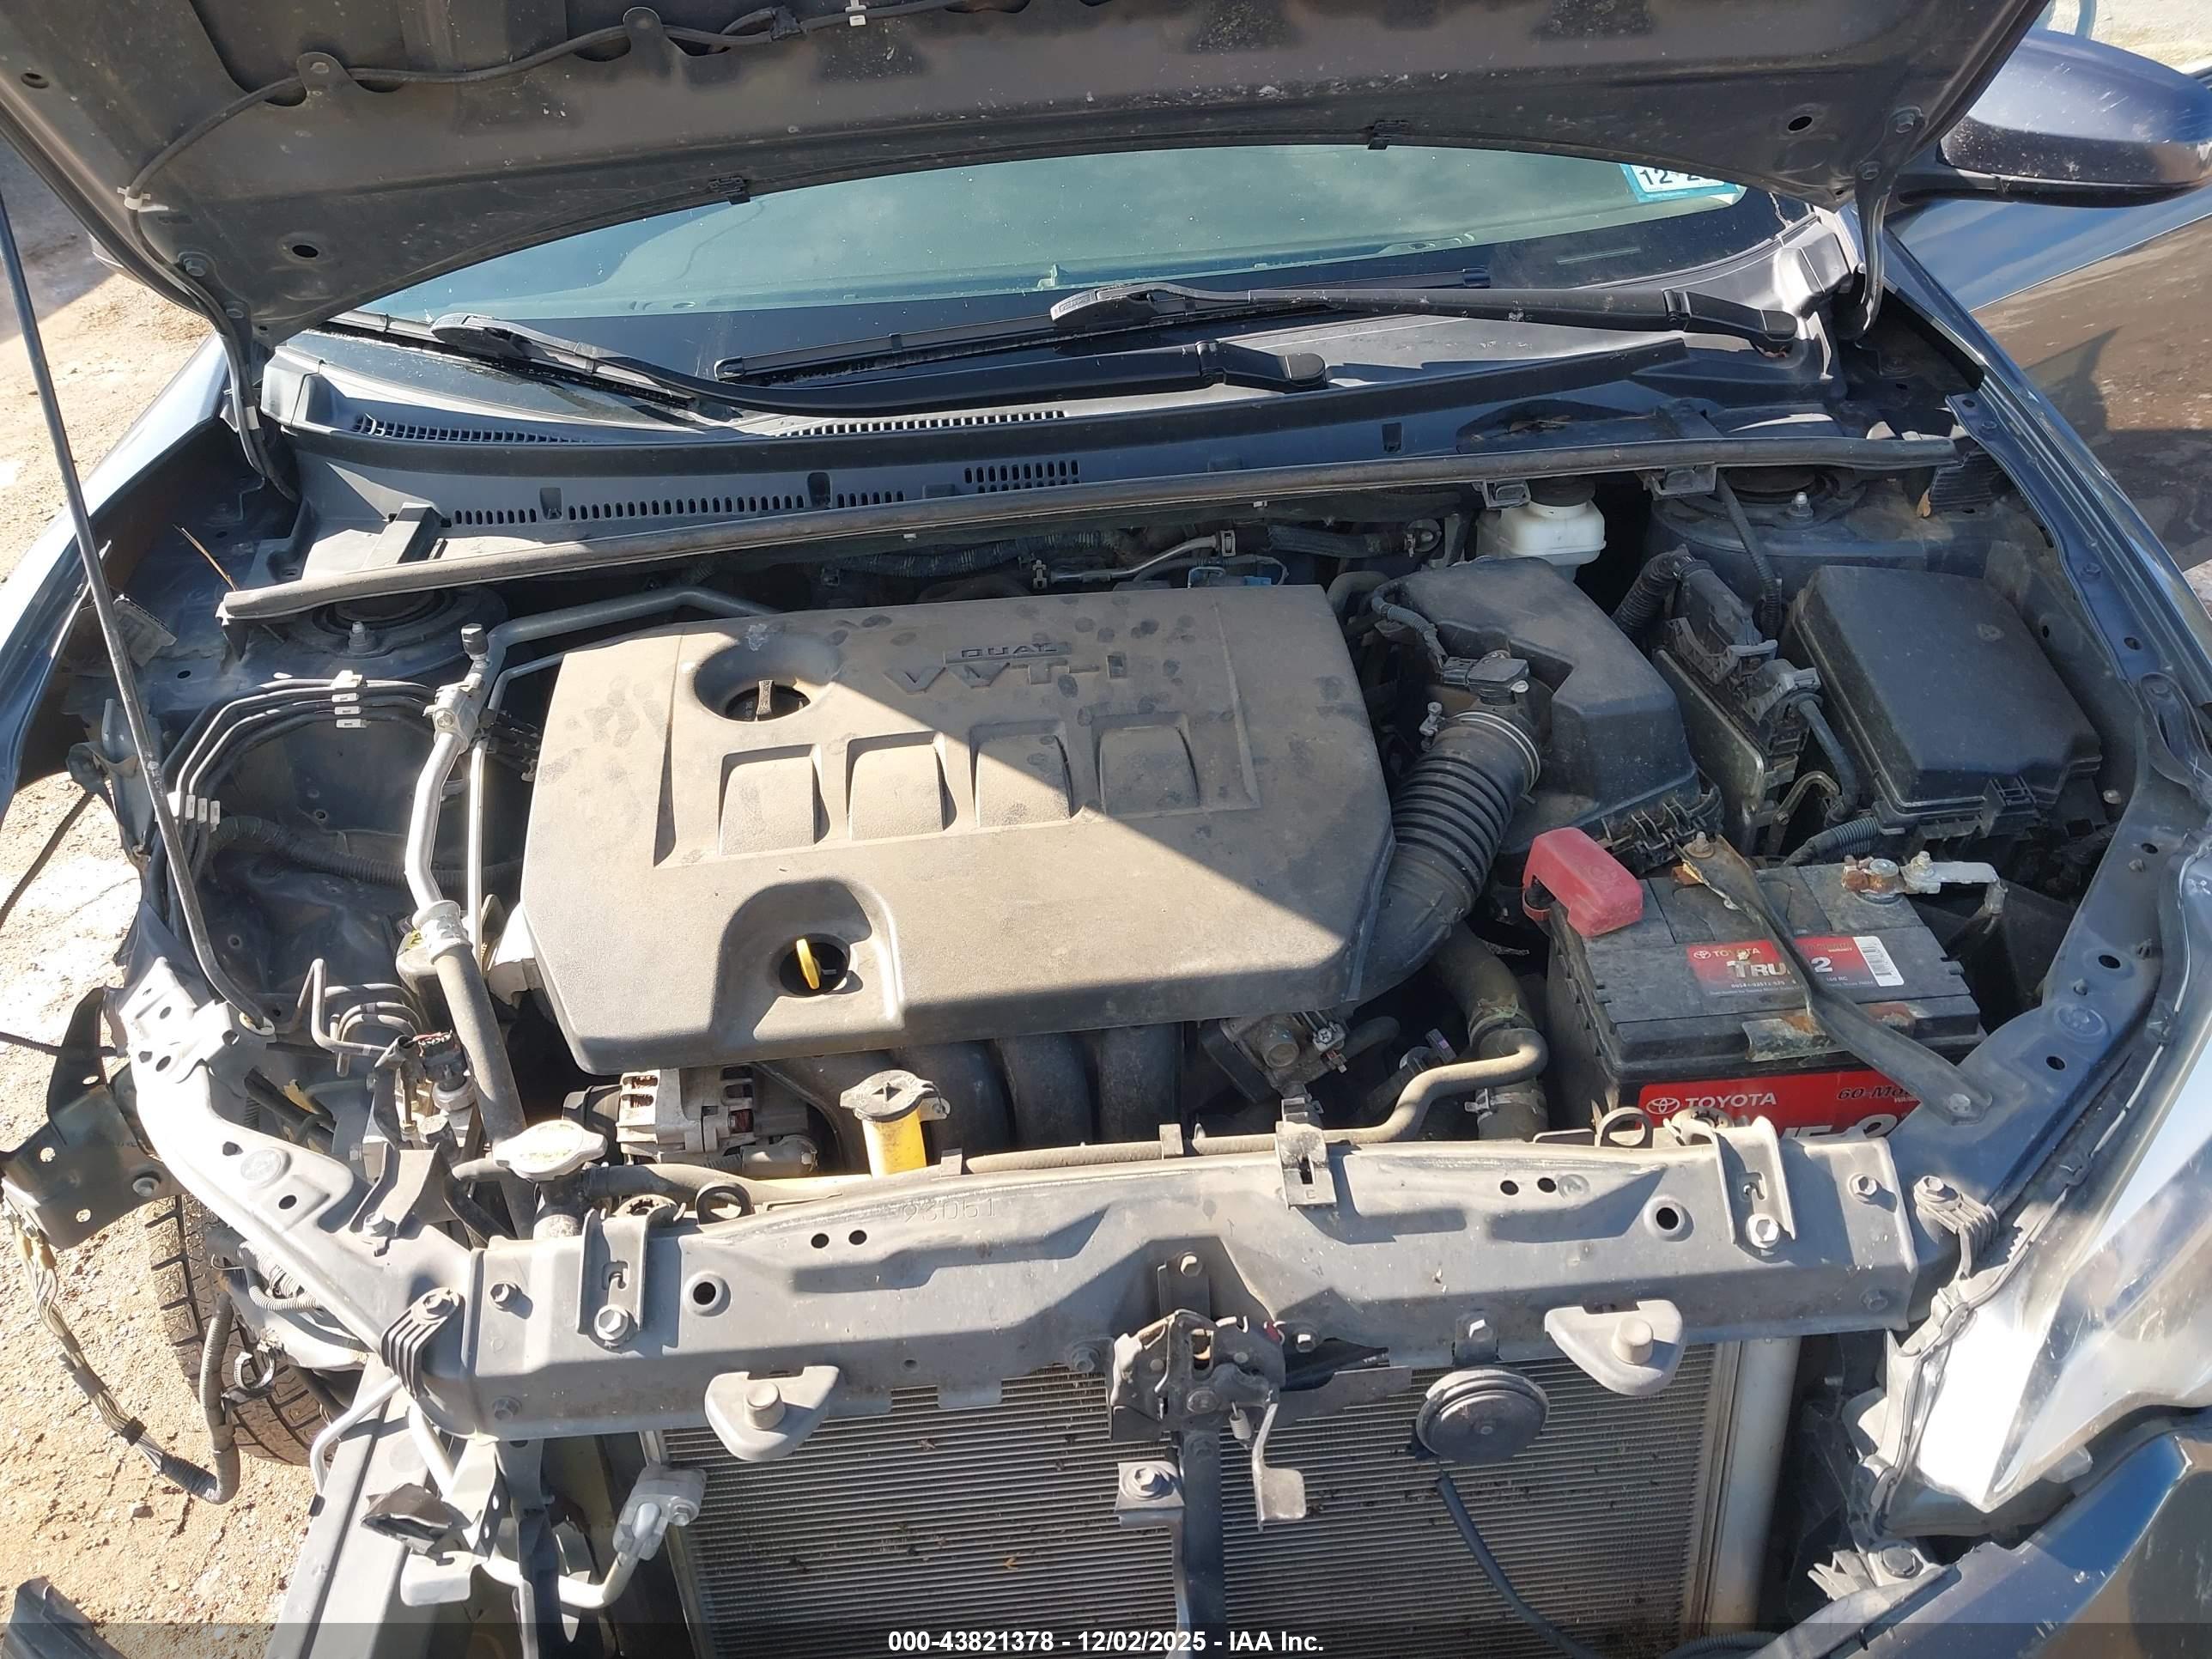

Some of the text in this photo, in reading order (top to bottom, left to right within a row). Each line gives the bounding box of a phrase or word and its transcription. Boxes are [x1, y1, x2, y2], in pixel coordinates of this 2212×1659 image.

[1639, 169, 1673, 185] 12
[962, 642, 1057, 658] DUAL
[1685, 1092, 1778, 1109] TOYOTA
